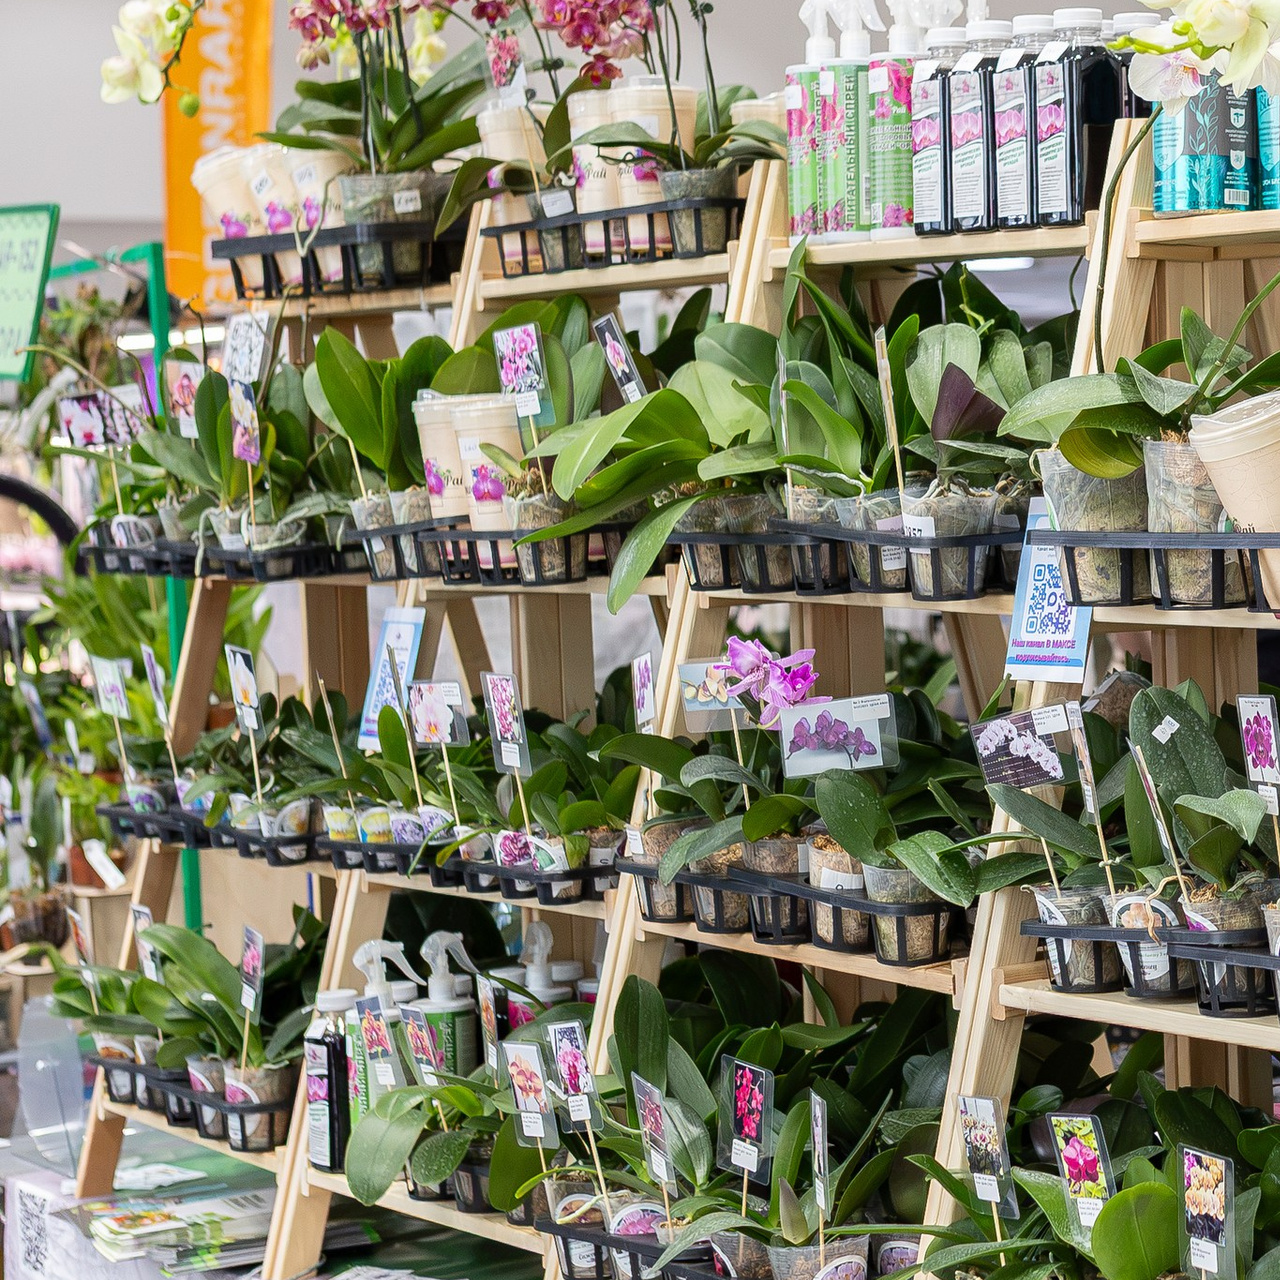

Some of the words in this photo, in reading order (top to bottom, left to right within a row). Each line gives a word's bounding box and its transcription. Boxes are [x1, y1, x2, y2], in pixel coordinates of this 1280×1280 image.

[843, 74, 856, 120] СПРЕЙ
[844, 124, 856, 223] ПИТАТЕЛЬНЫЙ
[1011, 638, 1026, 648] Наш
[1026, 640, 1045, 648] канал
[1046, 639, 1051, 648] В
[1052, 639, 1077, 650] МАКСЕ
